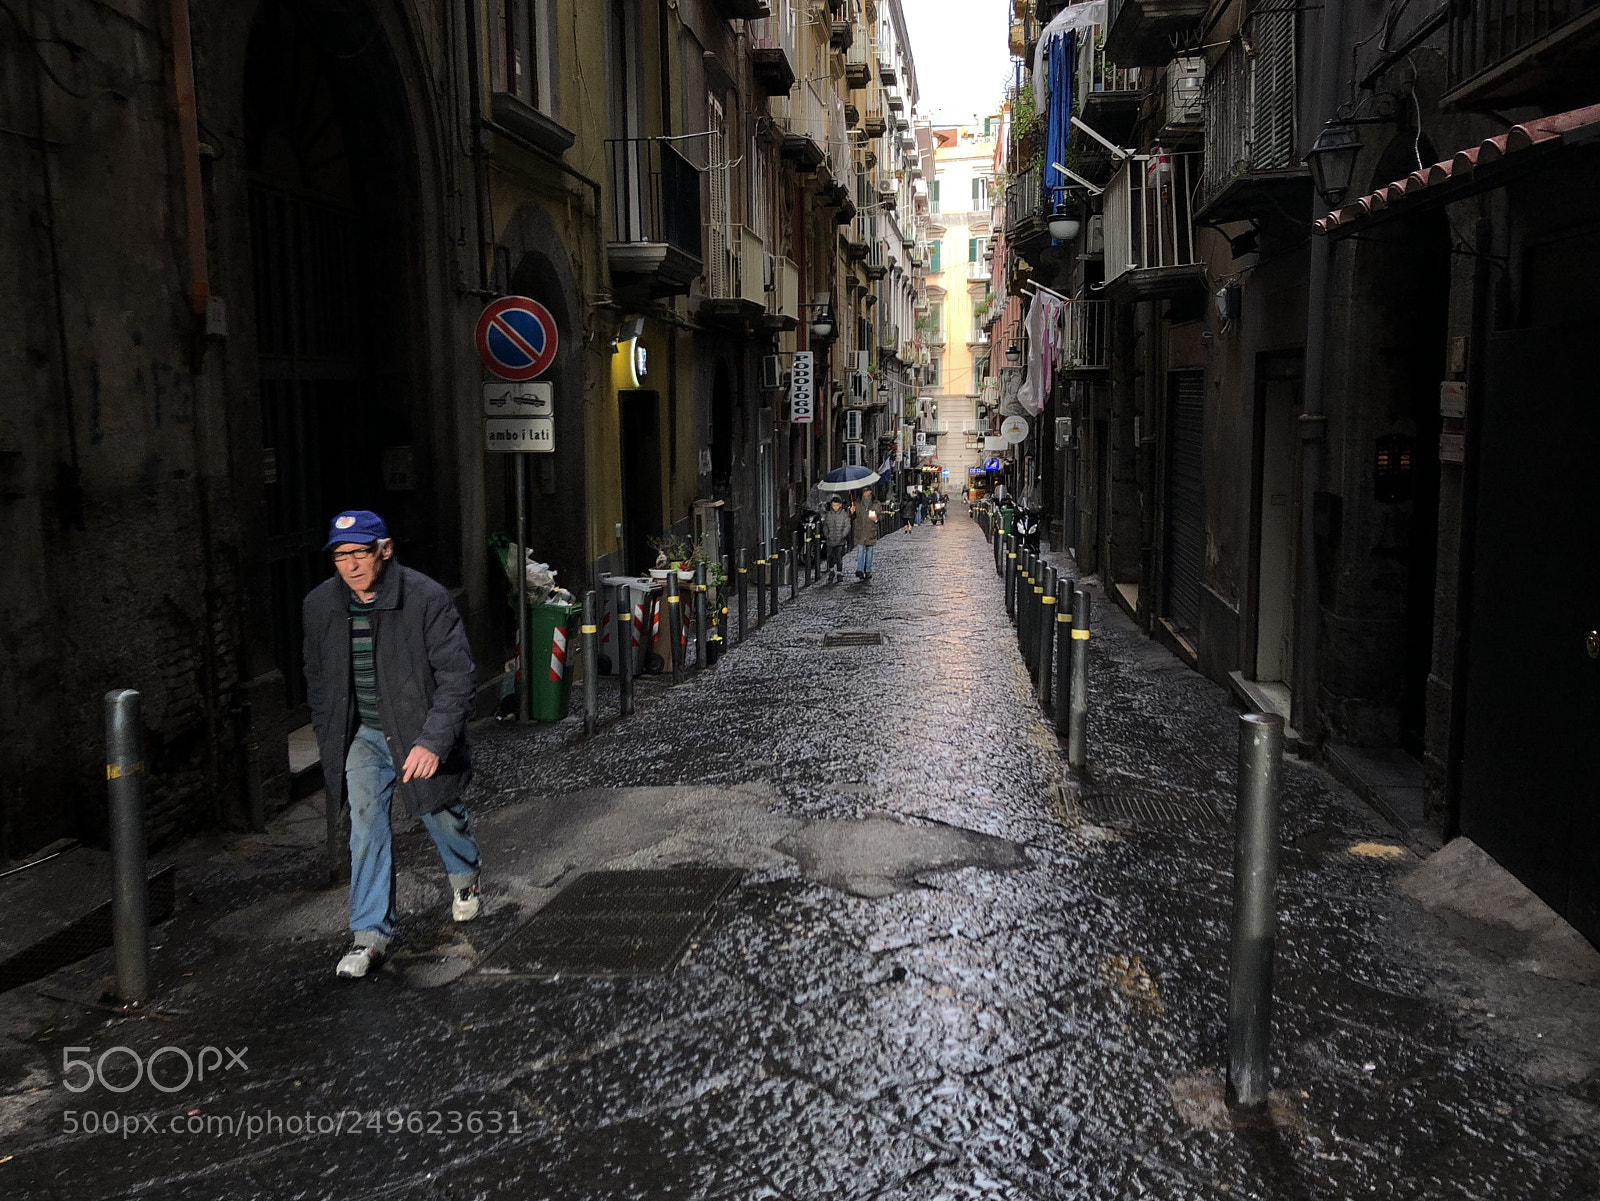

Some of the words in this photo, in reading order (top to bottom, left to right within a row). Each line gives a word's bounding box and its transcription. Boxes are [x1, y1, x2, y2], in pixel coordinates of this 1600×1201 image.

[794, 355, 810, 414] PODOLOGO
[489, 429, 518, 441] ambo
[521, 429, 526, 441] i
[529, 429, 550, 441] lati
